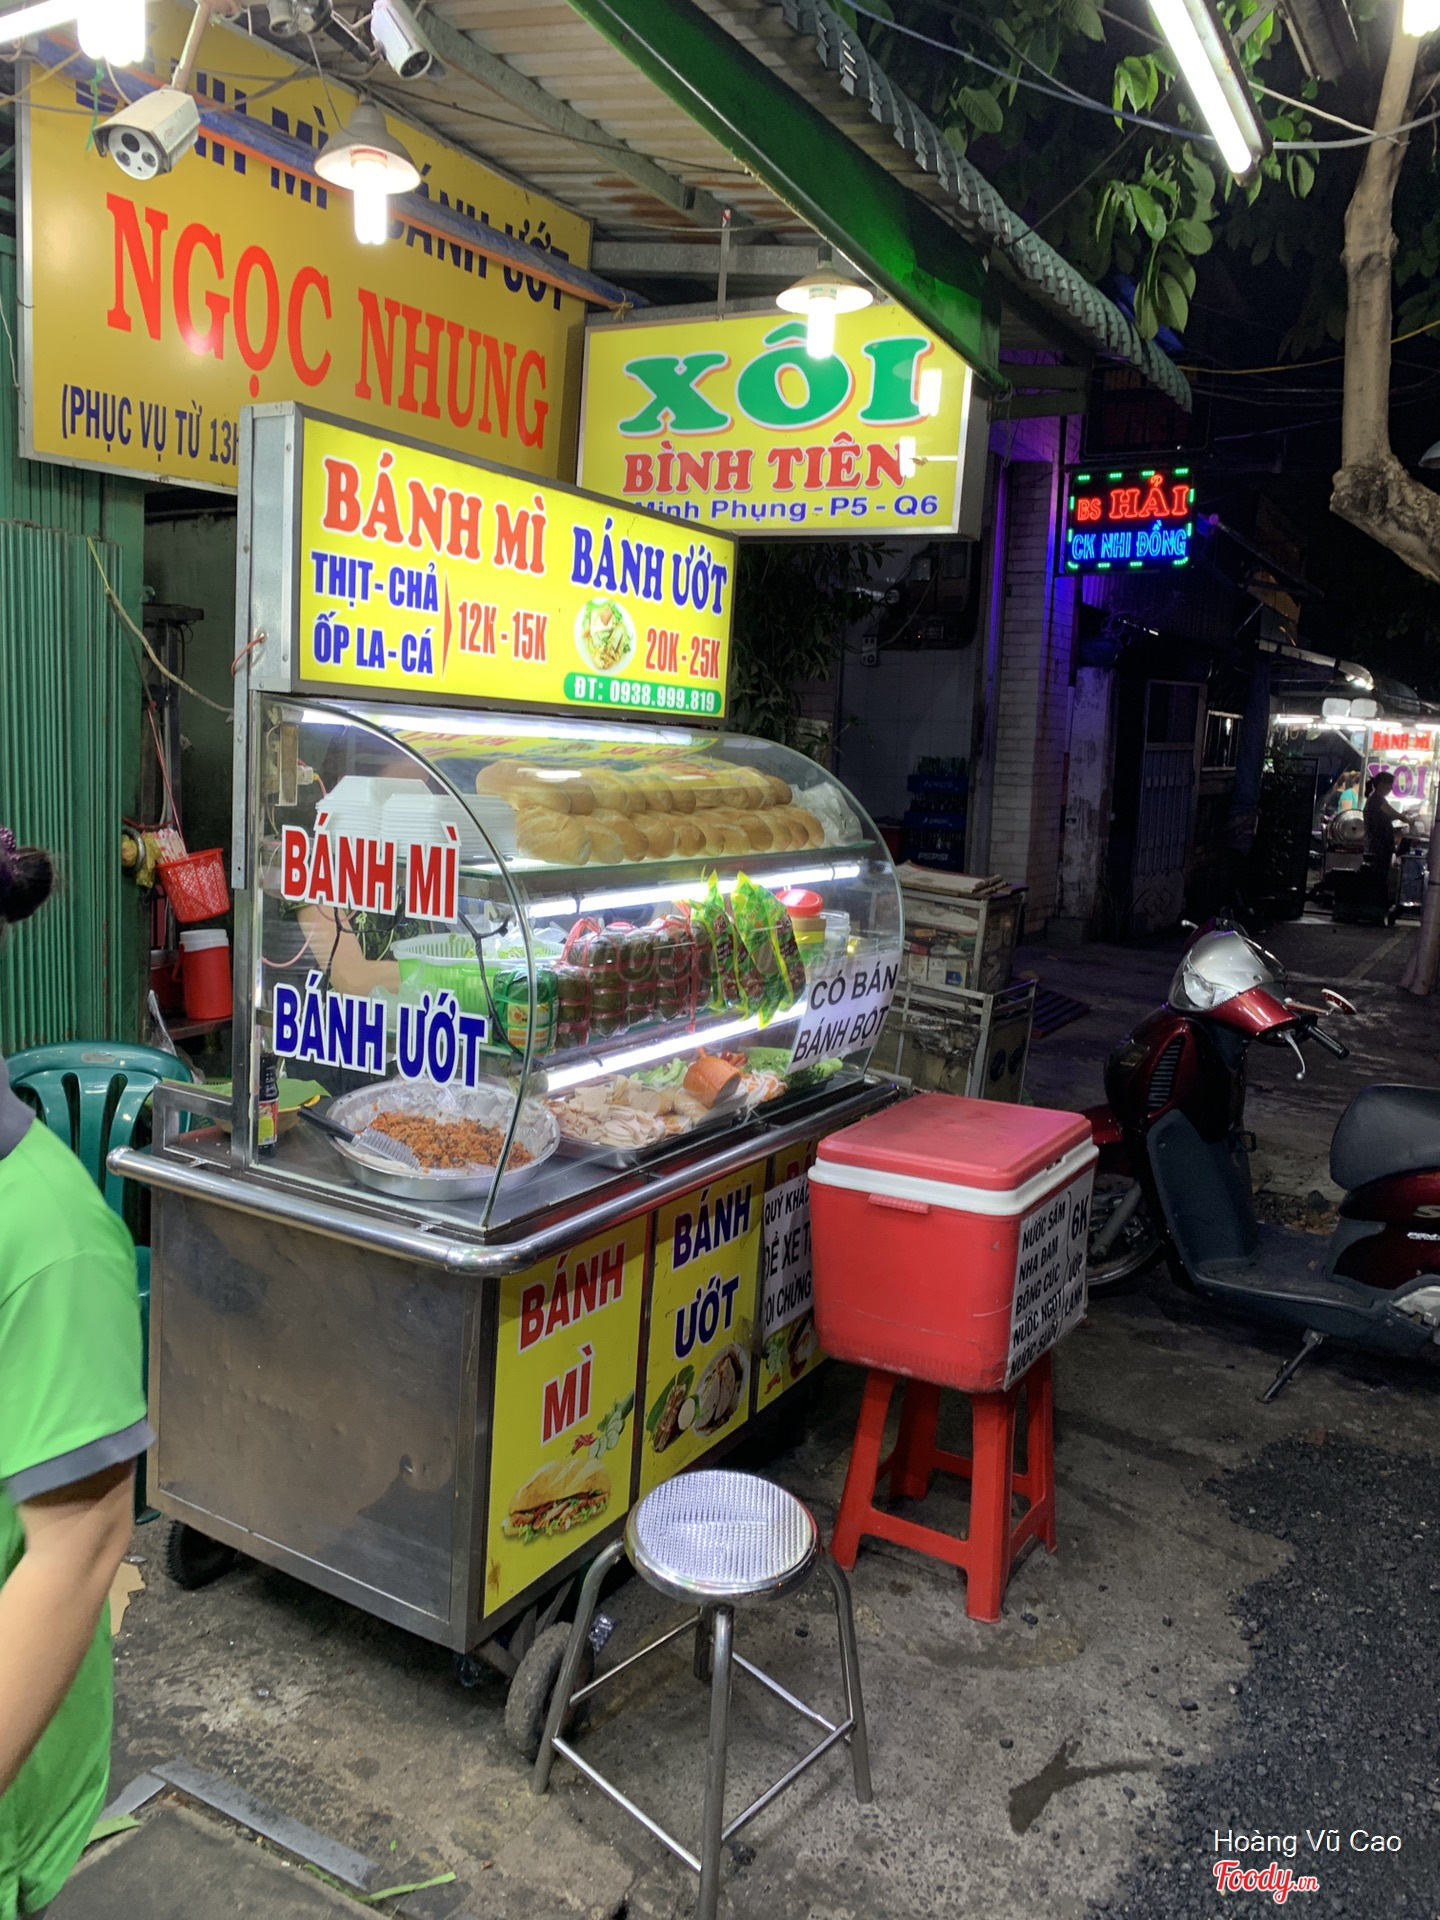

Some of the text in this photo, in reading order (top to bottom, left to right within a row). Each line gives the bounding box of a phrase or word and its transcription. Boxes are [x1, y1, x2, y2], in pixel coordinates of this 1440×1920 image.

[106, 191, 549, 450] NGỌC NHUNG
[618, 320, 935, 437] XÔI
[139, 400, 167, 462] VỤ
[174, 400, 203, 459] TỪ
[622, 430, 914, 494] BÌNH TIÊN
[322, 452, 547, 575] BÁNH MÌ
[1077, 474, 1190, 521] BS HẢI
[570, 517, 728, 615] BÁNH ƯỚT
[1071, 519, 1187, 560] CK NHI ĐỒNG
[313, 611, 350, 666] ỐP
[574, 675, 715, 713] ĐT: 0938.999.819
[282, 812, 461, 924] BÁNH MÌ
[810, 960, 899, 1011] CÓ BÁN
[273, 970, 489, 1091] BÁNH ƯỚT
[791, 1005, 890, 1064] BÁNH BỘT
[672, 1183, 753, 1271] BÁNH
[764, 1190, 784, 1226] QUÝ
[1071, 1194, 1090, 1241] 6K
[782, 1227, 801, 1270] XE
[1018, 1253, 1039, 1285] NHA
[518, 1242, 626, 1353] BÁNH
[674, 1272, 741, 1361] ƯỚT
[541, 1344, 596, 1447] MÌ
